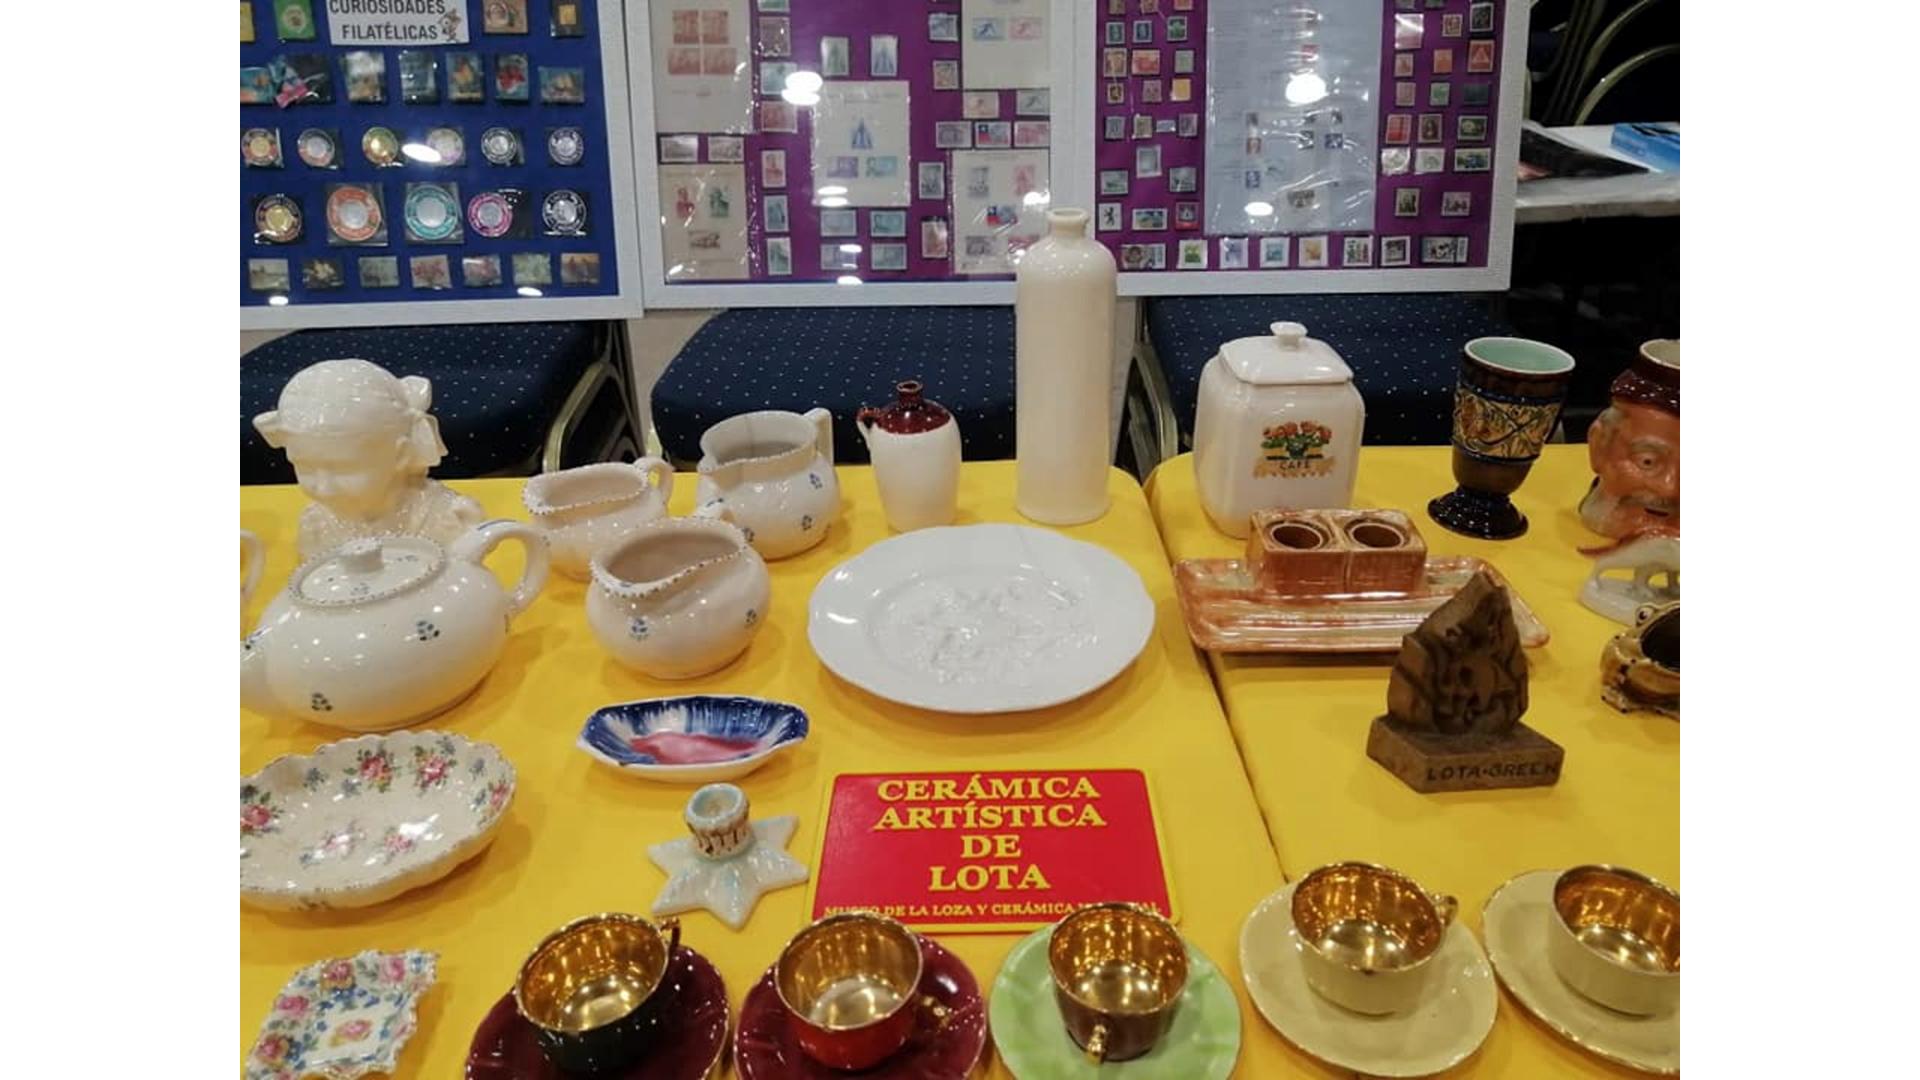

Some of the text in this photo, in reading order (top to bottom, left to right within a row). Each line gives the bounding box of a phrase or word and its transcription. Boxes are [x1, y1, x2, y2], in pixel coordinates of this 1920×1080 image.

[329, 0, 446, 14] CURIOSIDADES
[342, 22, 438, 40] FILATÉLICAS
[877, 774, 1101, 801] CERÁMICA
[873, 801, 1106, 830] ARTÍSTICA
[961, 835, 1022, 858] DE
[929, 865, 1050, 892] LOTA
[884, 905, 906, 916] DE
[909, 905, 929, 916] LA
[933, 904, 974, 916] LOZA
[977, 904, 988, 915] Y
[991, 901, 1075, 915] CERÁMICA
